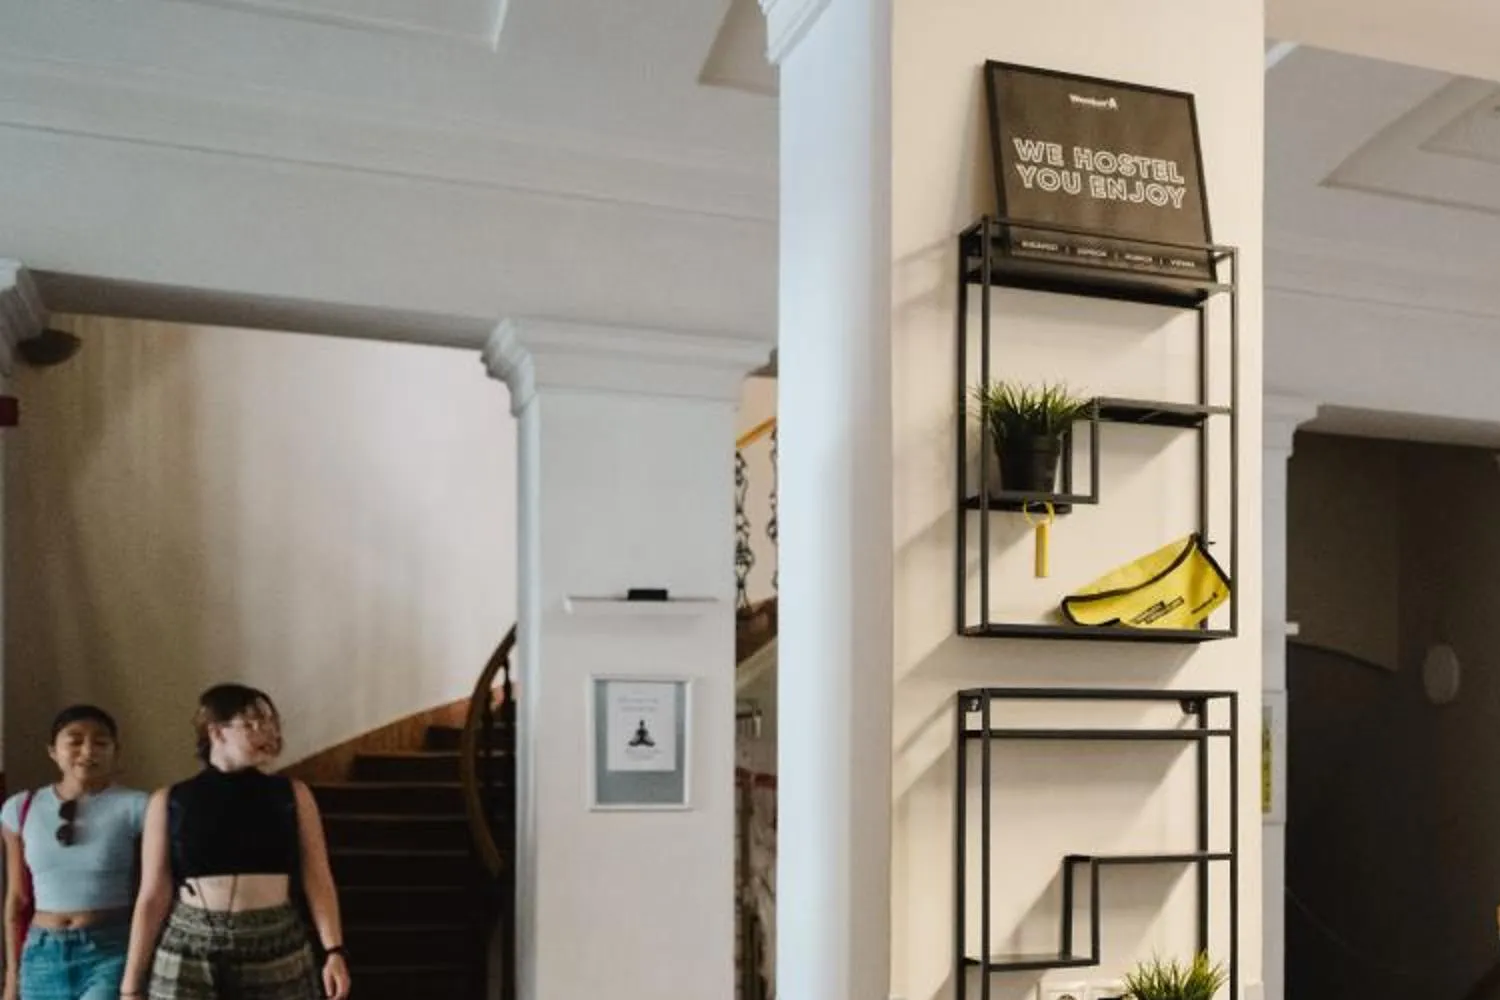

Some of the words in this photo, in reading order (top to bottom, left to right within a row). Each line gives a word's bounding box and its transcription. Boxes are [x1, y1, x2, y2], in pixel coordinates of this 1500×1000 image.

[1013, 137, 1064, 167] WE
[1073, 146, 1185, 185] HOSTEL
[1016, 163, 1081, 195] YOU
[1089, 174, 1187, 209] ENJOY
